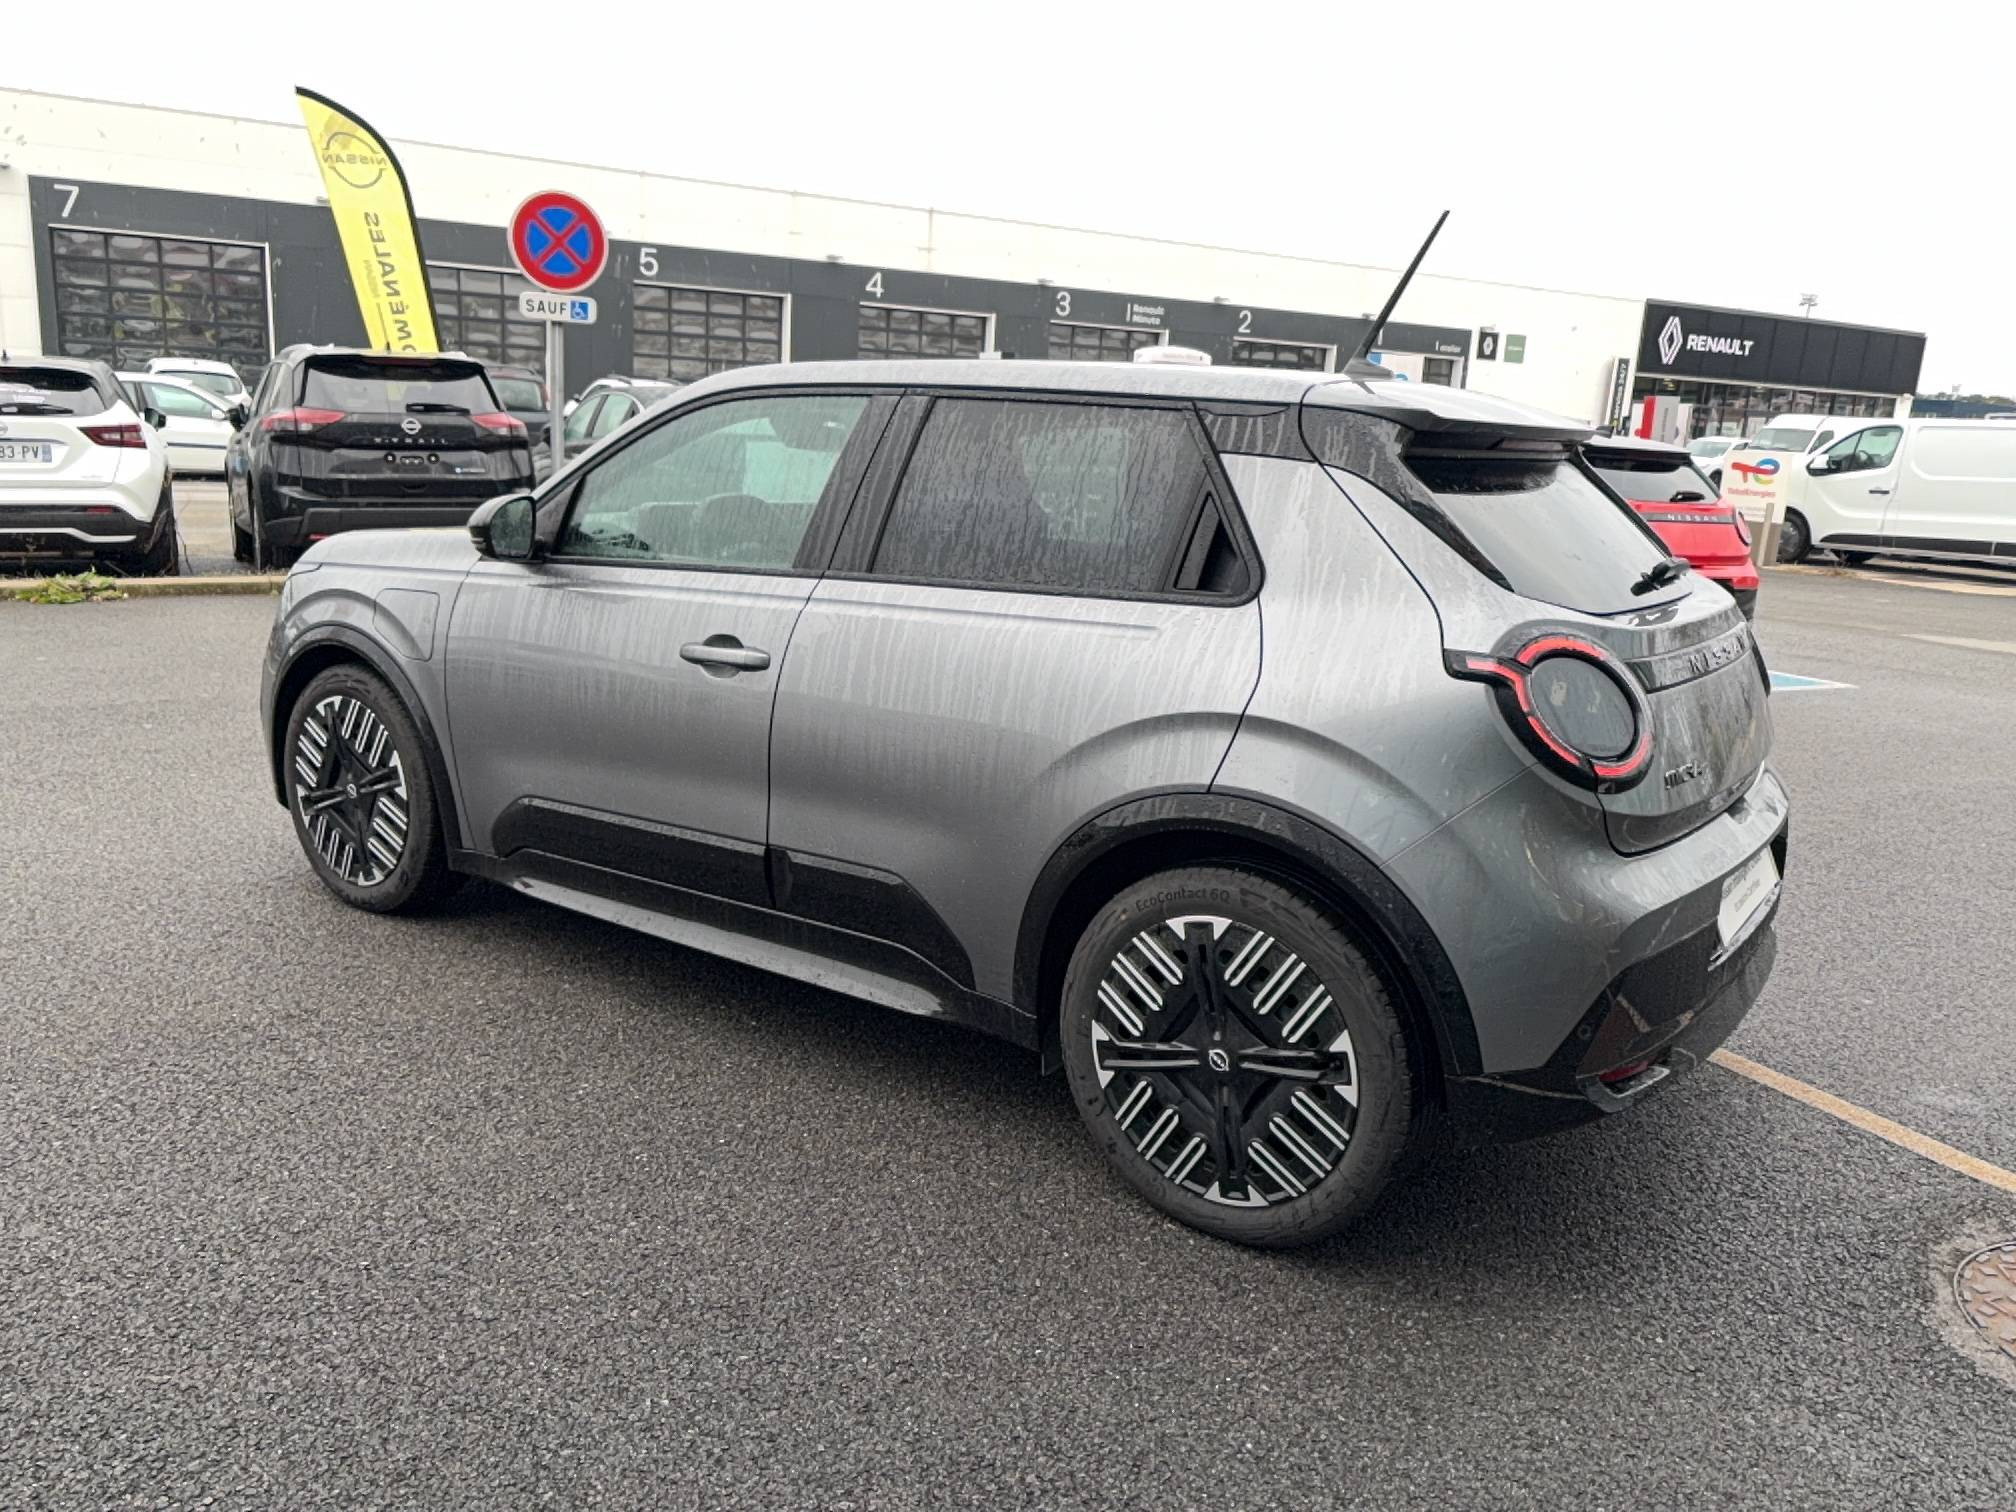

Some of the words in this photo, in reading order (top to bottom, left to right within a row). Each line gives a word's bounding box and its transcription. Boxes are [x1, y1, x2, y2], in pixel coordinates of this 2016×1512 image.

[53, 183, 80, 218] 7
[639, 247, 659, 277] 5
[865, 271, 885, 299] 4
[525, 299, 567, 315] SAUF
[1055, 291, 1071, 317] 3
[1237, 310, 1252, 334] 2
[1686, 333, 1755, 357] RENAULT
[1135, 887, 1207, 913] EcoContact
[1209, 888, 1231, 904] 6Q
